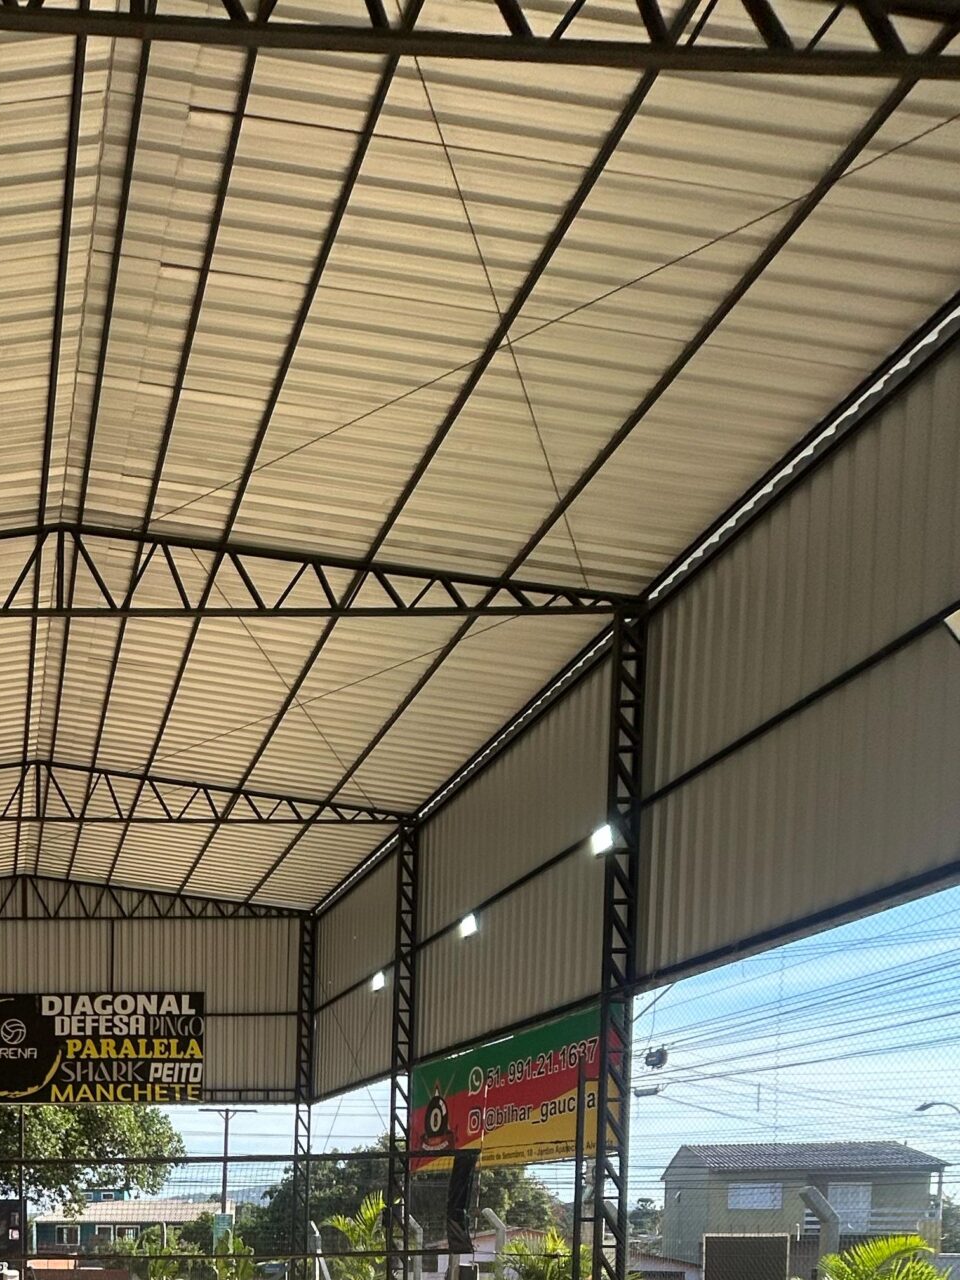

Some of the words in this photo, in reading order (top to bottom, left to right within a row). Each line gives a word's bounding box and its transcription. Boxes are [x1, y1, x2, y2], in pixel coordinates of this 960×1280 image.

[41, 994, 195, 1016] DIAGONAL
[54, 1015, 145, 1036] DEFESA
[149, 1016, 204, 1037] PINGO
[66, 1038, 203, 1059] PARALELA
[60, 1061, 144, 1082] SHARK
[148, 1062, 203, 1083] PEITO
[50, 1083, 202, 1102] MANCHETE
[484, 1091, 596, 1132] @bilhar_gauca
